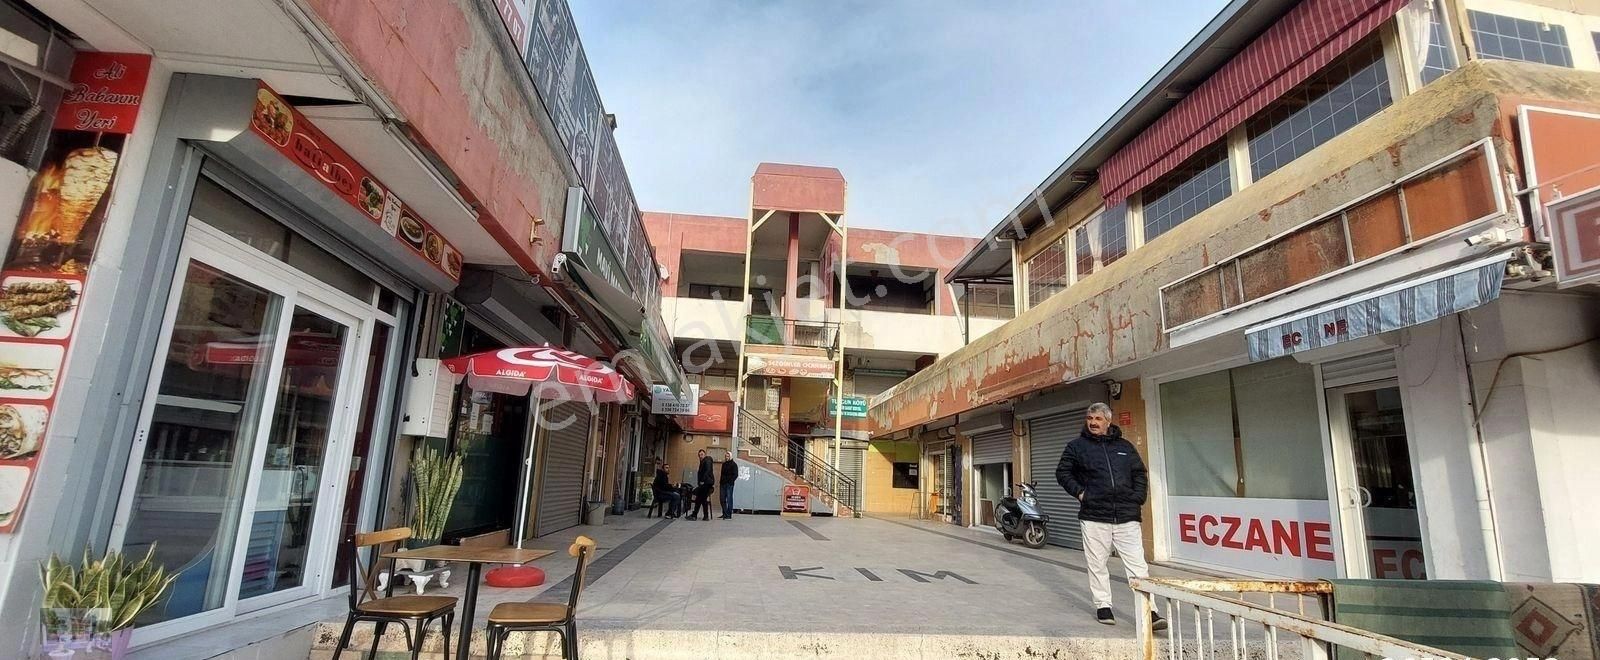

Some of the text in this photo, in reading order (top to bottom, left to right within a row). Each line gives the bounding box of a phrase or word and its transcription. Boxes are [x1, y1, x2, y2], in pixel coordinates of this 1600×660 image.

[93, 60, 127, 80] Ali
[75, 107, 118, 130] Yeri
[495, 369, 525, 378] ALGIDA
[579, 374, 603, 384] ALGIDA
[1179, 513, 1334, 561] ECZANE
[777, 565, 979, 585] KIM
